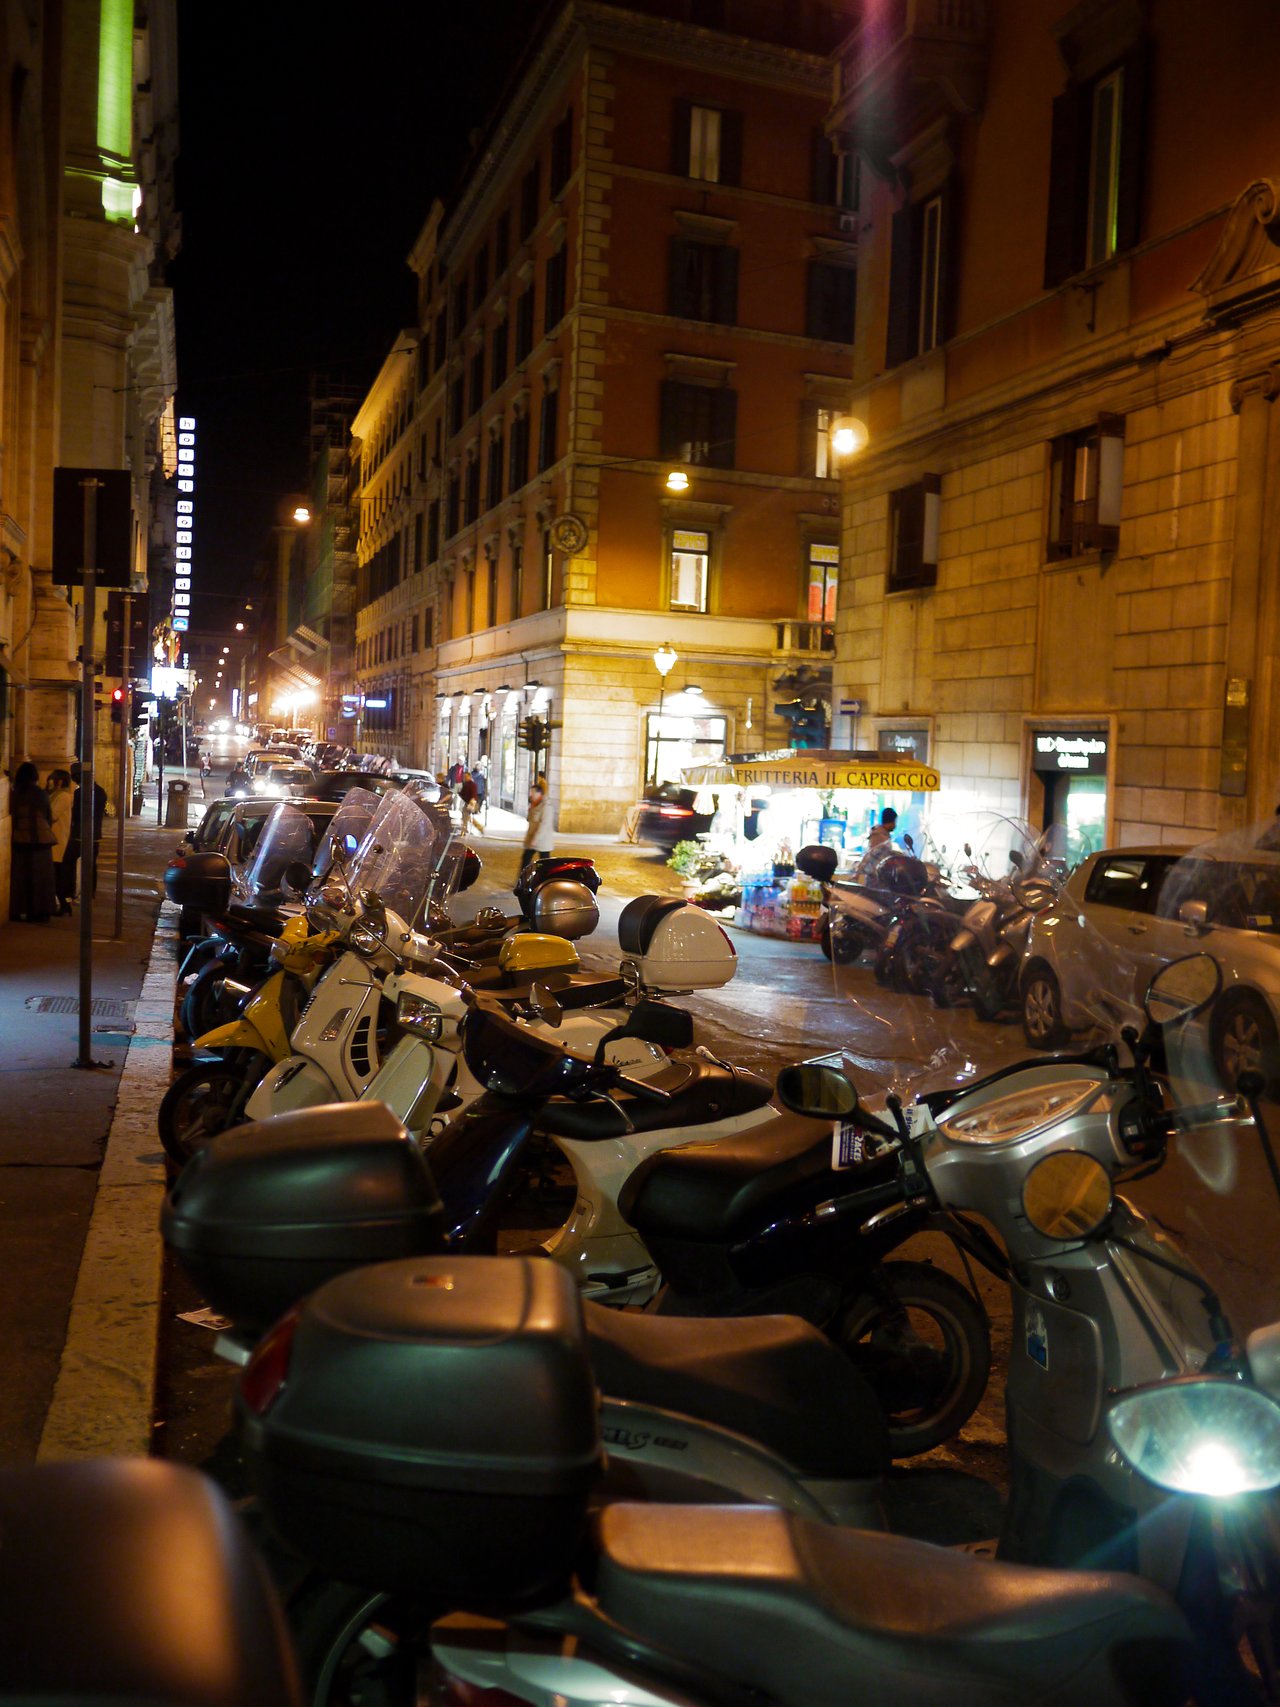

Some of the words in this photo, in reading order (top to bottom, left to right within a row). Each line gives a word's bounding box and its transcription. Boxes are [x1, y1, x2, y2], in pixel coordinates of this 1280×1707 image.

[736, 769, 819, 785] FRUTTERIA
[825, 771, 841, 786] IL
[846, 772, 937, 788] CAPRICCIO
